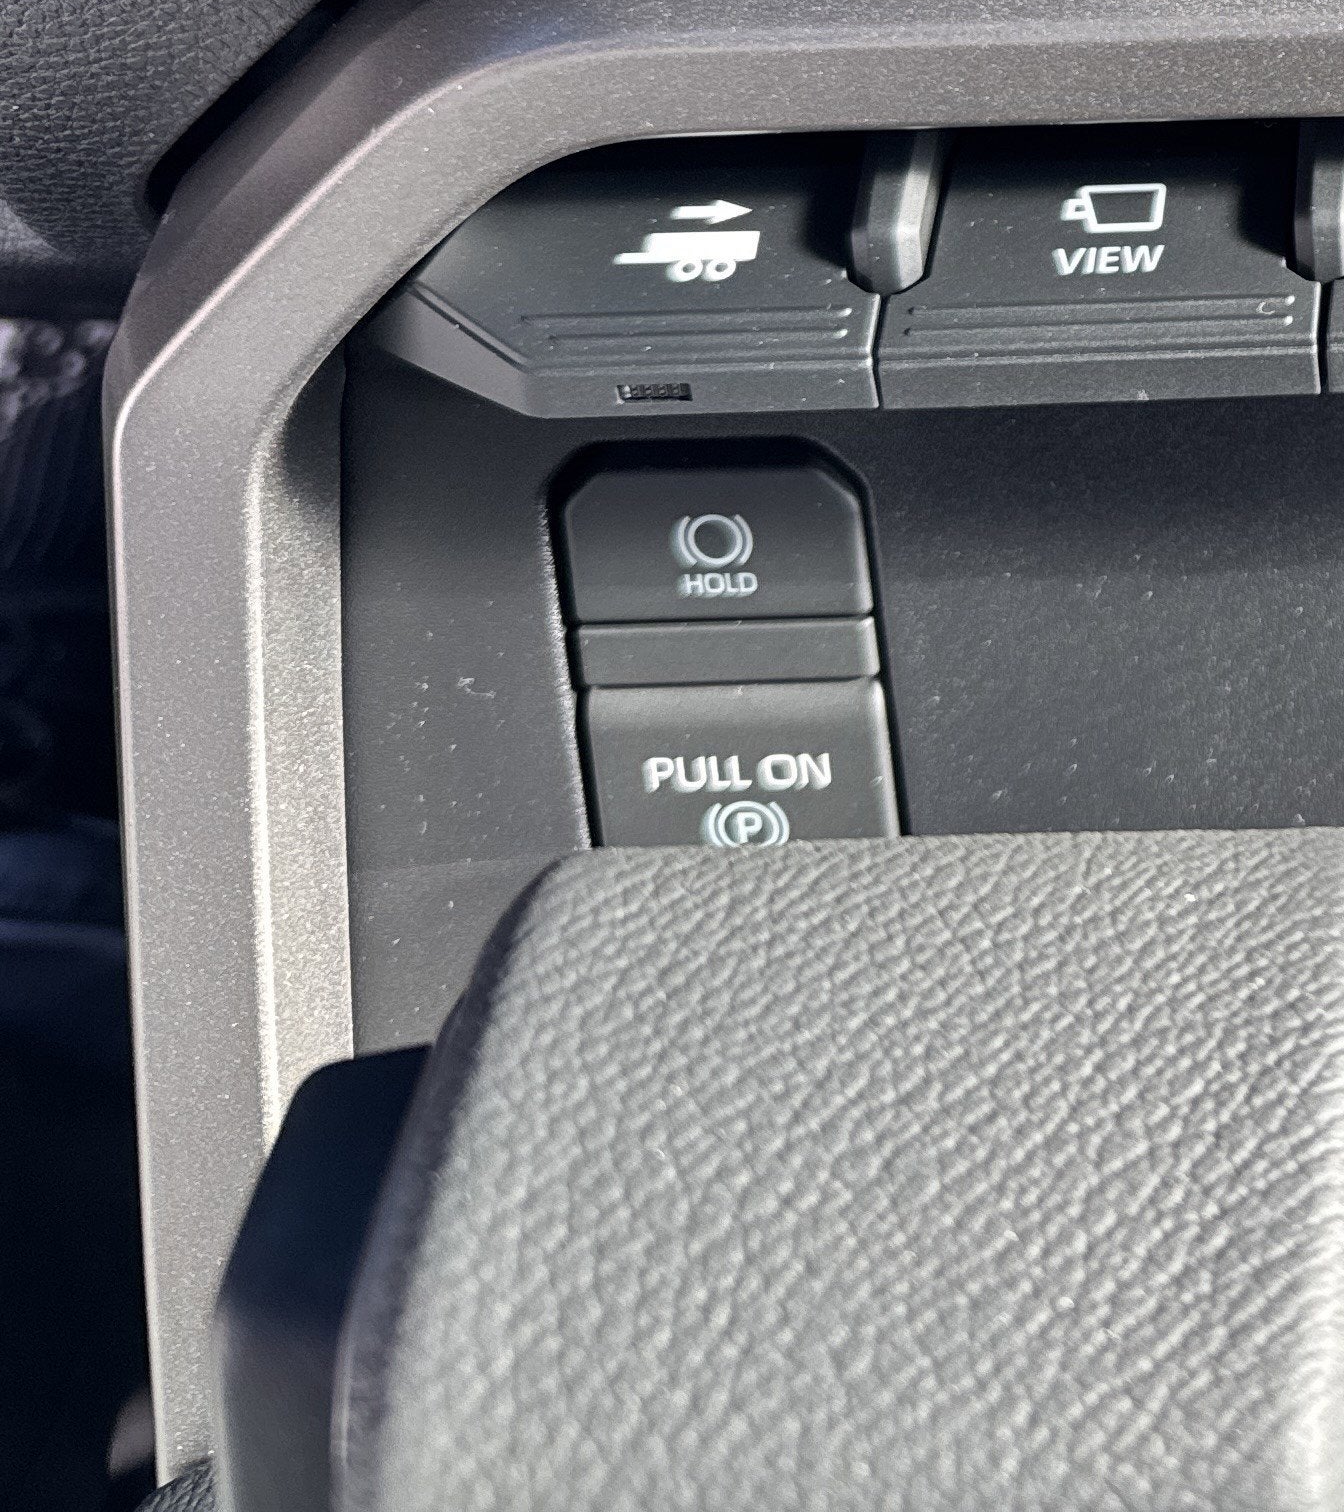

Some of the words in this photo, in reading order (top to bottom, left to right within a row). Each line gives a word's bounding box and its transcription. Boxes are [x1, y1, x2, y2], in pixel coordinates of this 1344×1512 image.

[1052, 244, 1164, 274] VIEW
[680, 572, 758, 597] HOLD
[642, 755, 752, 793] PULL
[757, 753, 832, 790] ON
